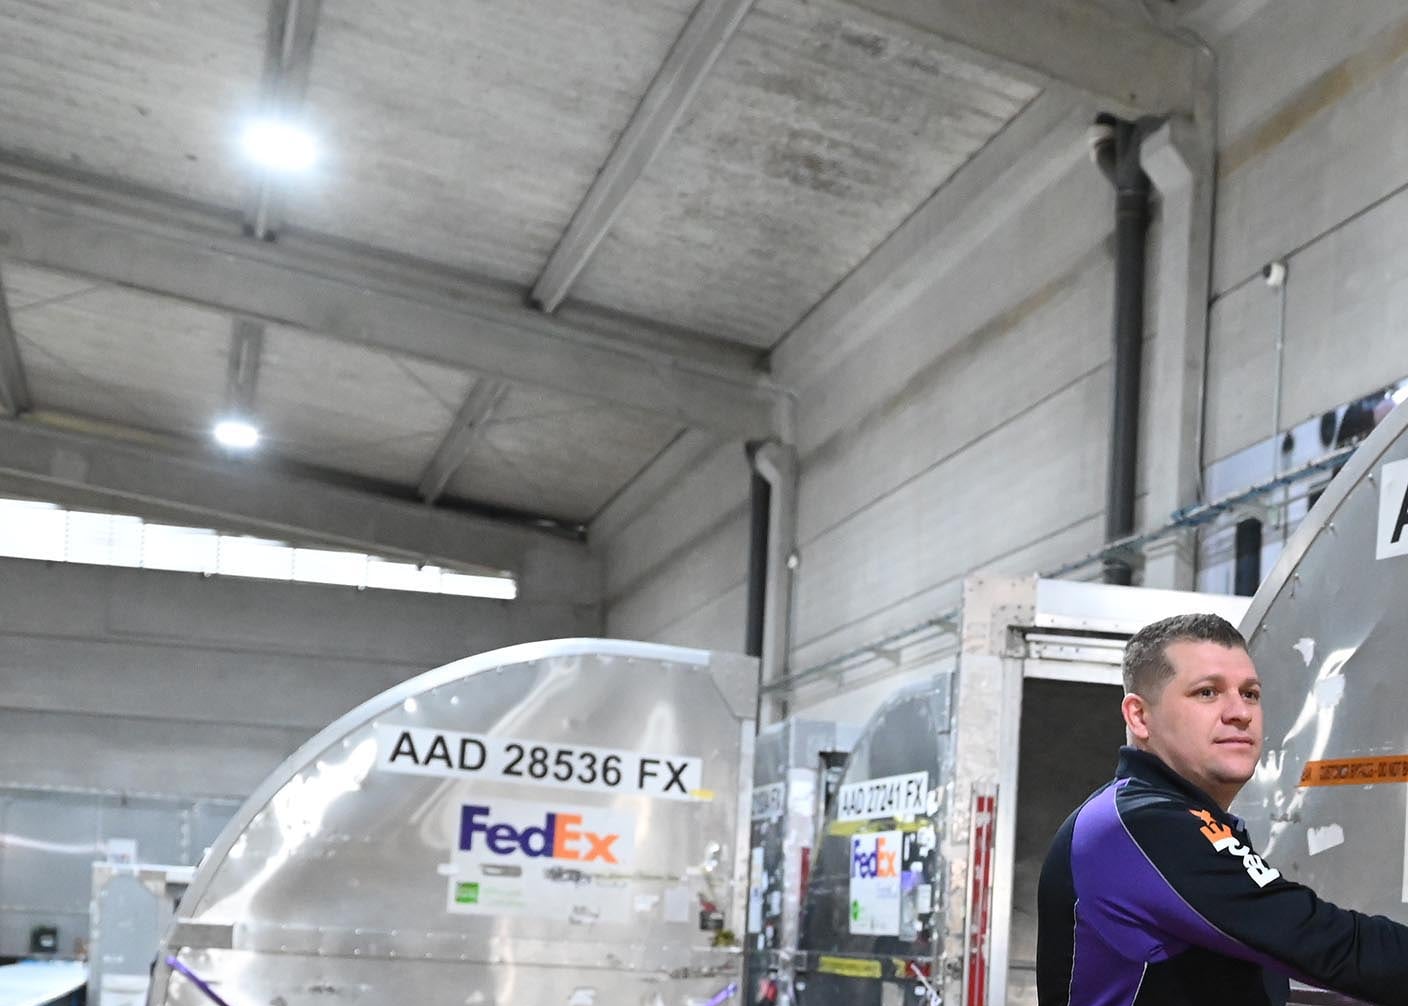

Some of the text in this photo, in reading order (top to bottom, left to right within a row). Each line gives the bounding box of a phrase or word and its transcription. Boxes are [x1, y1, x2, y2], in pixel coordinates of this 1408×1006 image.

[389, 731, 689, 794] AAD 28536 FX
[905, 779, 924, 808] FX
[458, 804, 620, 864] FedEx
[852, 837, 897, 879] FedEx
